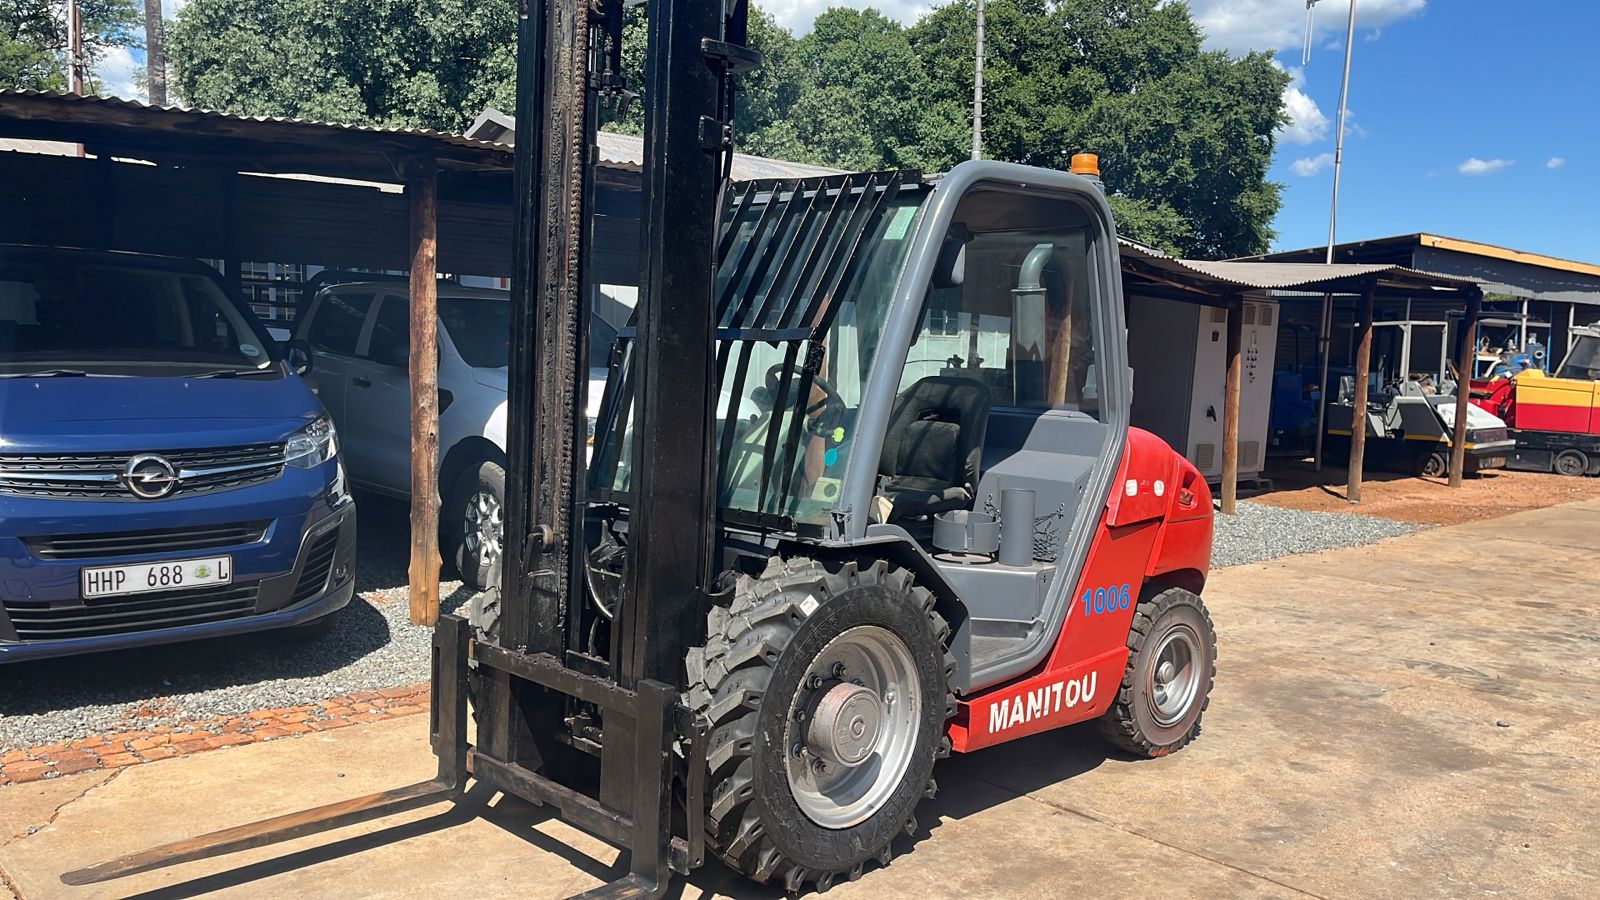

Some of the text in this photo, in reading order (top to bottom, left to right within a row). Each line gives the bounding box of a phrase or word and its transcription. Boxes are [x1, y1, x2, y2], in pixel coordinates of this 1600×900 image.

[88, 561, 228, 593] HHP 688 L
[1081, 583, 1131, 616] 1006
[988, 671, 1098, 734] MANITOU
